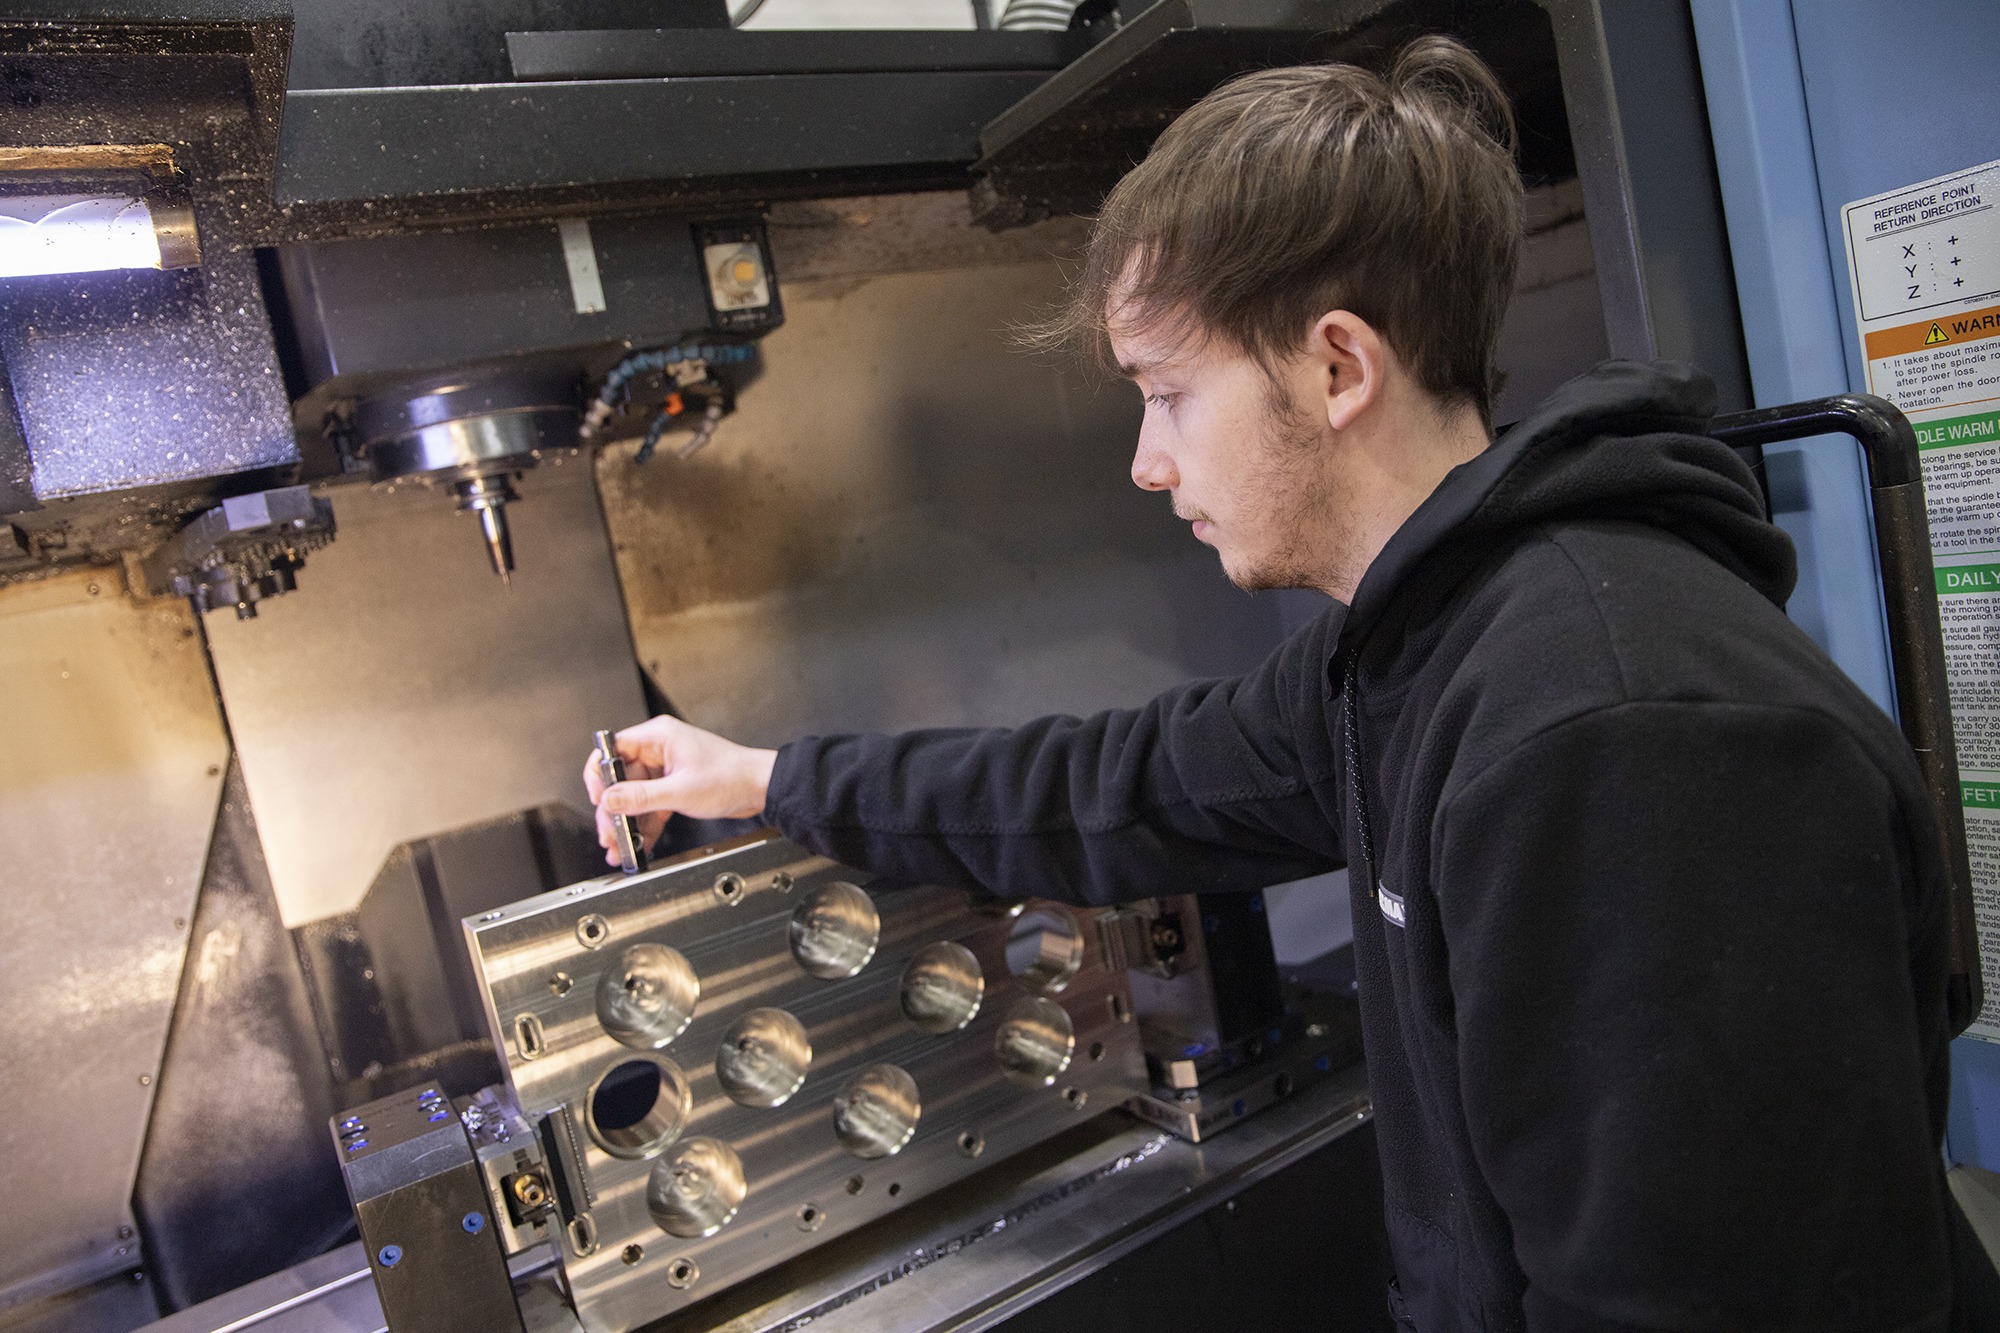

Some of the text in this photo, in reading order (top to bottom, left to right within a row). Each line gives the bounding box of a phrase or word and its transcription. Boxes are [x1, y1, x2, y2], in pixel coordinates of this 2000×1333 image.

[1874, 184, 1975, 220] REFERENCE POINT
[1874, 195, 1982, 232] RETURN DIRECTION
[1902, 244, 1916, 258] X
[1905, 264, 1917, 278] Y
[1908, 285, 1921, 299] Z
[1882, 362, 1890, 370] 1.
[1894, 360, 1900, 368] It
[1904, 354, 1930, 366] takes
[1934, 348, 1960, 360] about
[1908, 365, 1928, 376] stop
[1932, 362, 1946, 371] the
[1950, 354, 1986, 368] spindle
[1896, 367, 1978, 388] after power loss.
[1898, 388, 1926, 399] Never
[1930, 384, 1954, 394] open
[1958, 380, 1973, 390] the
[1978, 376, 2000, 386] door
[1900, 396, 1944, 409] roatation.
[1948, 420, 1994, 440] WARM
[1921, 455, 1945, 464] olong
[1948, 452, 1961, 460] the
[1964, 448, 1996, 458] service
[1933, 462, 1974, 472] bearings,
[1934, 473, 1958, 481] warm
[1961, 470, 1972, 480] up
[1944, 478, 1994, 488] equipment.
[1928, 498, 1944, 506] that
[1946, 496, 1960, 504] the
[1962, 492, 1994, 504] spindle
[1940, 506, 1954, 514] the
[1956, 502, 2000, 514] guarantee
[1956, 514, 1980, 522] warm
[1983, 512, 1994, 520] up
[1940, 530, 1964, 538] rotate
[1967, 528, 1981, 536] the
[1952, 538, 1967, 546] tool
[1980, 536, 1994, 544] the
[1946, 570, 2000, 587] DAILY
[1959, 605, 1990, 613] moving
[1952, 613, 1992, 622] operation
[1980, 660, 1994, 668] the
[1964, 788, 2000, 802] FET
[1983, 862, 1996, 870] the
